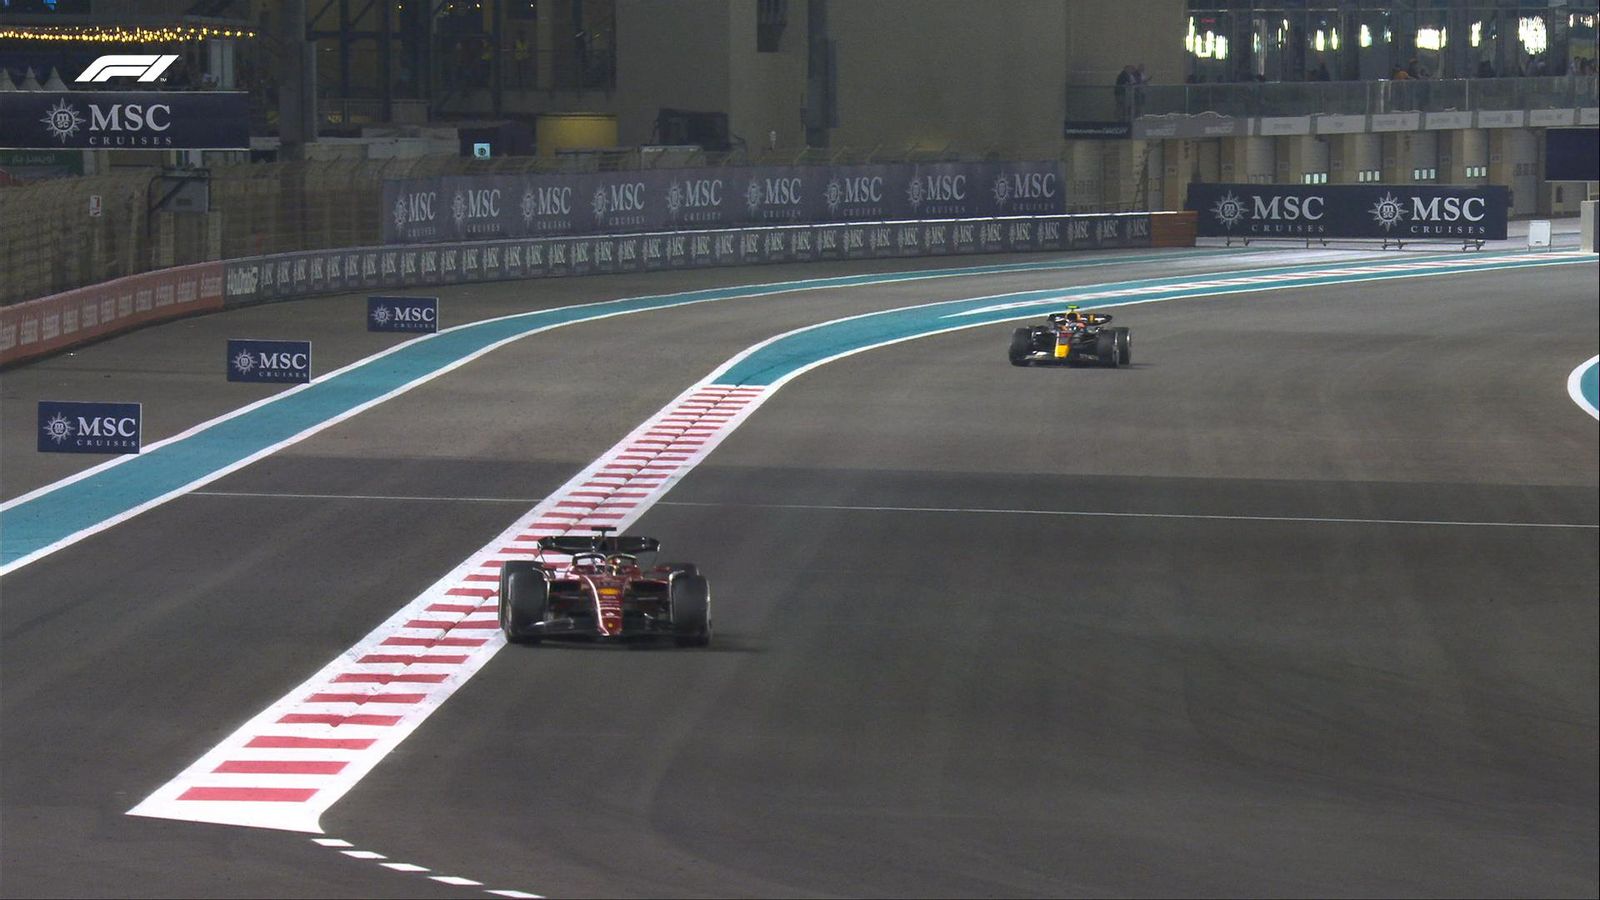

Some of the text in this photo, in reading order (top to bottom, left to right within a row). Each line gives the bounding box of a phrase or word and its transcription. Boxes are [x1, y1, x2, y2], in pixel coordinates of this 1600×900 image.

[89, 104, 171, 132] MSC
[89, 136, 172, 146] CRUISES
[610, 182, 645, 212] MSC
[685, 179, 722, 207] MSC
[765, 178, 802, 205] MSC
[845, 176, 883, 203] MSC
[927, 174, 966, 201] MSC
[1014, 173, 1056, 199] MSC
[408, 191, 436, 222] MSC
[468, 189, 501, 218] MSC
[537, 187, 572, 215] MSC
[1252, 195, 1324, 220] MSC
[1411, 196, 1485, 222] MSC
[1251, 224, 1325, 233] CRUISES
[1411, 225, 1486, 234] CRUISES
[394, 306, 434, 322] MSC
[259, 352, 307, 370] MSC
[77, 416, 136, 437] MSC
[76, 440, 137, 448] CRUISES
